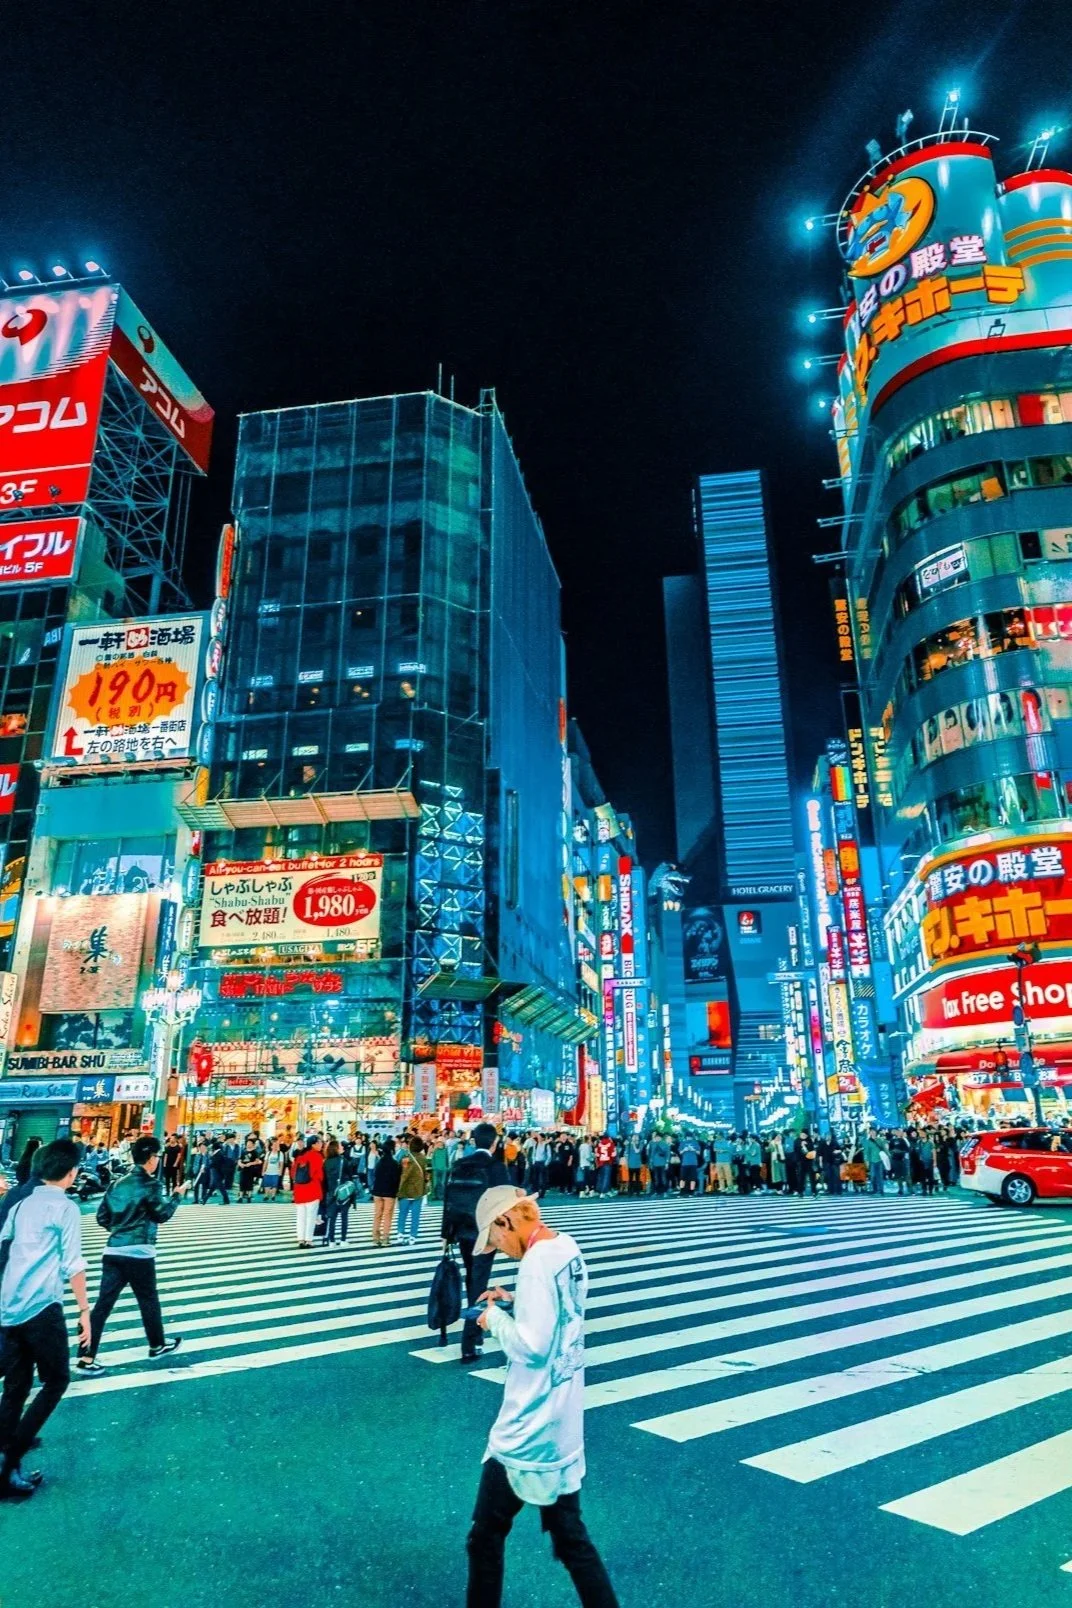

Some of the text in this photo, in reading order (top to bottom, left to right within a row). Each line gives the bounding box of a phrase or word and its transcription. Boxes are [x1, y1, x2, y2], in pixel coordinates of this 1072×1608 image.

[138, 367, 186, 439] アコム
[24, 561, 44, 573] 5F
[78, 625, 195, 651] 一軒め酒場
[88, 667, 177, 707] 190円
[87, 735, 177, 755] 左の路地を右へ
[339, 859, 346, 867] 2
[350, 856, 380, 867] hours
[928, 847, 1065, 901] 驚安の殿堂
[210, 876, 294, 896] しゃぶしゃぶ
[732, 884, 793, 895] HOTEL GRACERY
[210, 907, 288, 928] 食べ放題!
[303, 893, 356, 921] 1,980
[620, 874, 633, 935] SHIDAX
[942, 997, 960, 1020] Tax
[961, 991, 1005, 1015] Free
[857, 1003, 874, 1057] カラオケ
[880, 1083, 892, 1118] カラオケ
